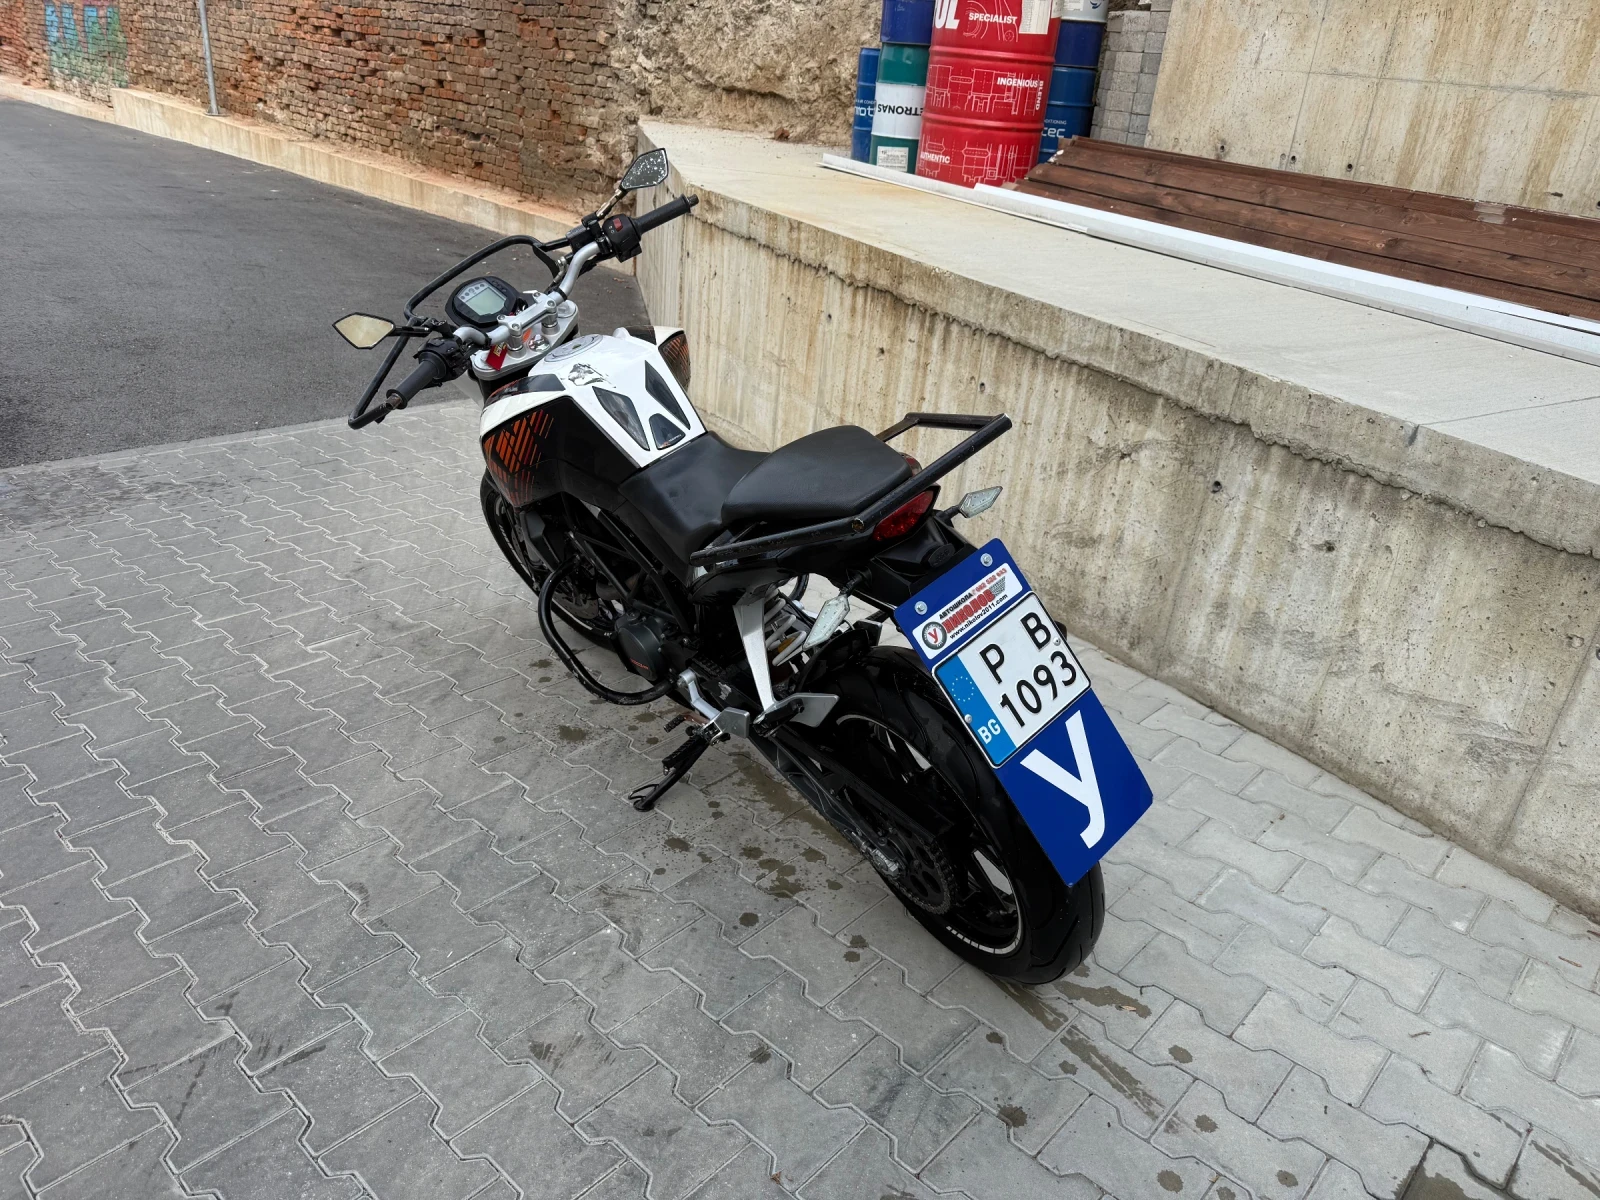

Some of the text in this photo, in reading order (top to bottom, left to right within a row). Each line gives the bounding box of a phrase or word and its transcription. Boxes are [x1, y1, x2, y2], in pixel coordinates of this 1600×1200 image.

[968, 12, 1018, 24] SPECIALIST
[996, 77, 1038, 88] INGENIOUS
[1035, 80, 1044, 111] BLEND
[942, 588, 995, 634] НИКОЛОВ
[950, 593, 1008, 640] www.nikolov2011.com
[979, 612, 1051, 684] P B
[998, 651, 1077, 728] 1093
[977, 718, 1001, 744] BG
